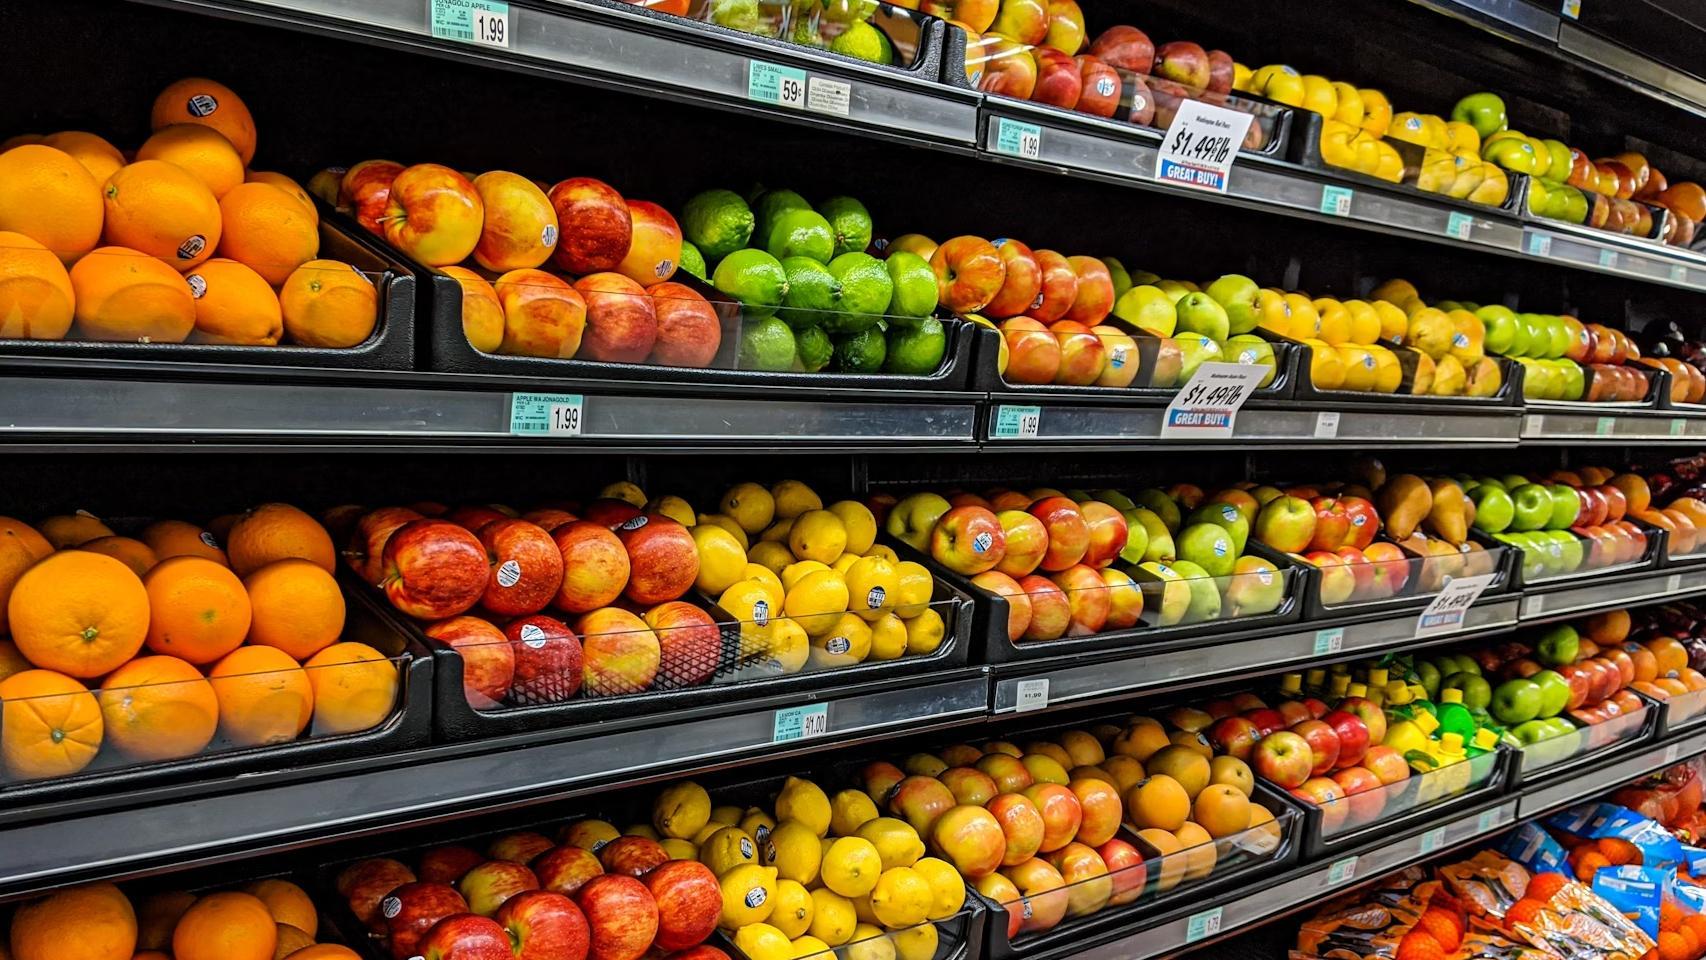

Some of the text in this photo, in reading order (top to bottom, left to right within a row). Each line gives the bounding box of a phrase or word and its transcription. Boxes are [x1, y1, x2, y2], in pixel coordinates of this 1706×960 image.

[471, 3, 491, 11] APPLE
[478, 16, 504, 42] 1.99
[767, 66, 782, 74] SMALL
[1024, 136, 1038, 155] 1.99
[1171, 127, 1216, 160] $1.49
[1167, 164, 1196, 181] GREAT
[1197, 171, 1219, 187] BUY!
[1184, 384, 1228, 405] $1.49
[555, 408, 578, 429] 1.99
[1023, 416, 1036, 433] 1.99
[1175, 412, 1225, 425] GREAT BUY!
